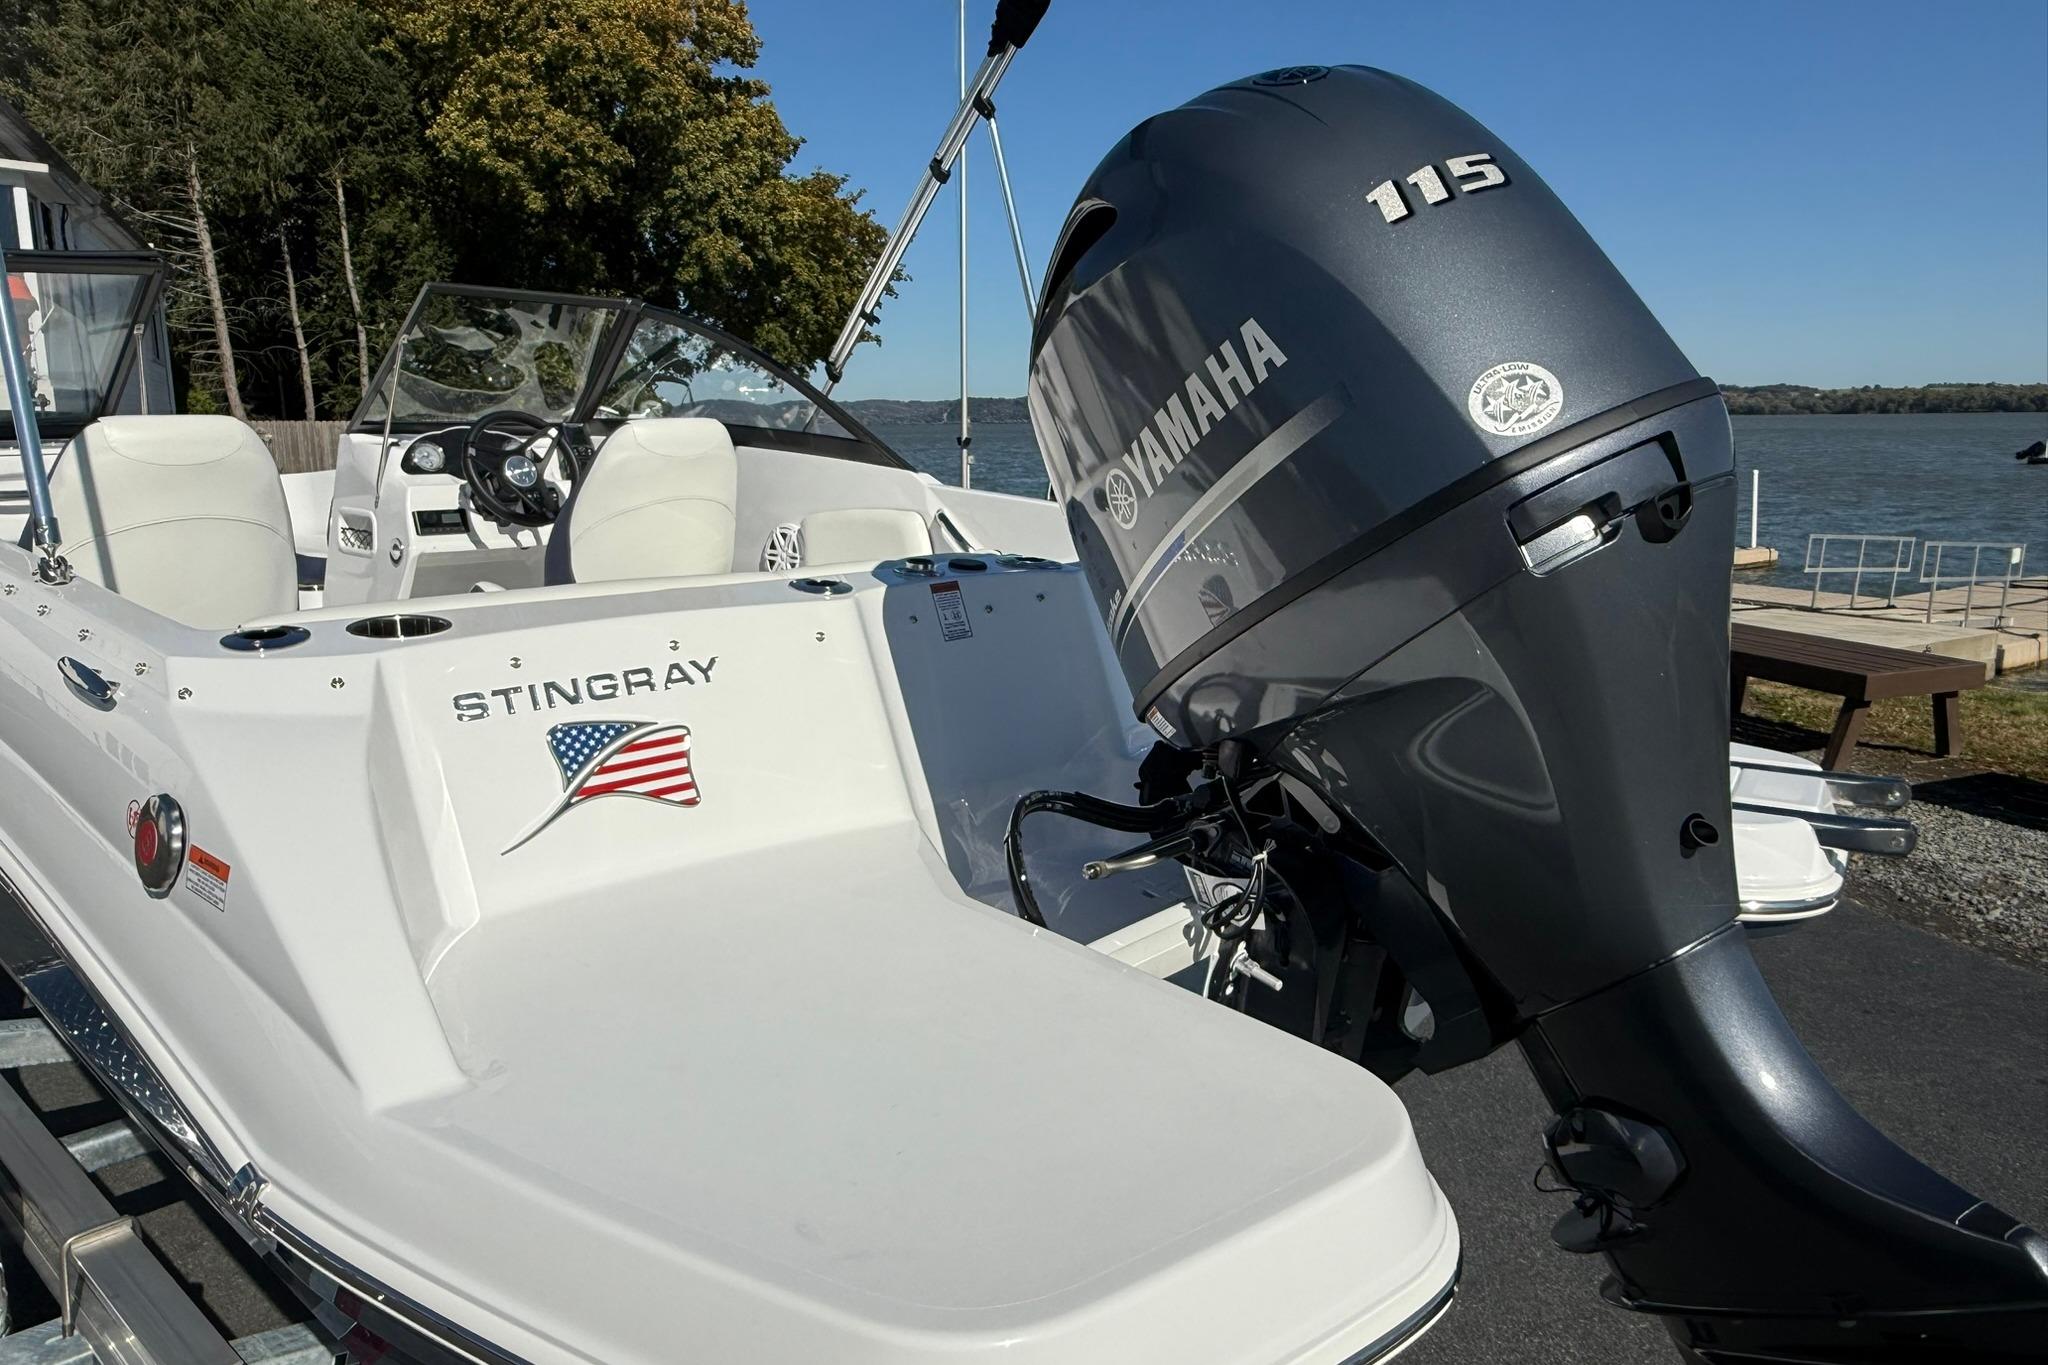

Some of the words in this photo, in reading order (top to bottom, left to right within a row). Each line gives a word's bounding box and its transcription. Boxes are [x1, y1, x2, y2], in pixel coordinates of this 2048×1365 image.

[1366, 153, 1507, 224] 115
[1122, 317, 1288, 498] YAMAHA
[1511, 407, 1557, 433] EMISSION
[452, 656, 719, 722] STINGRAY
